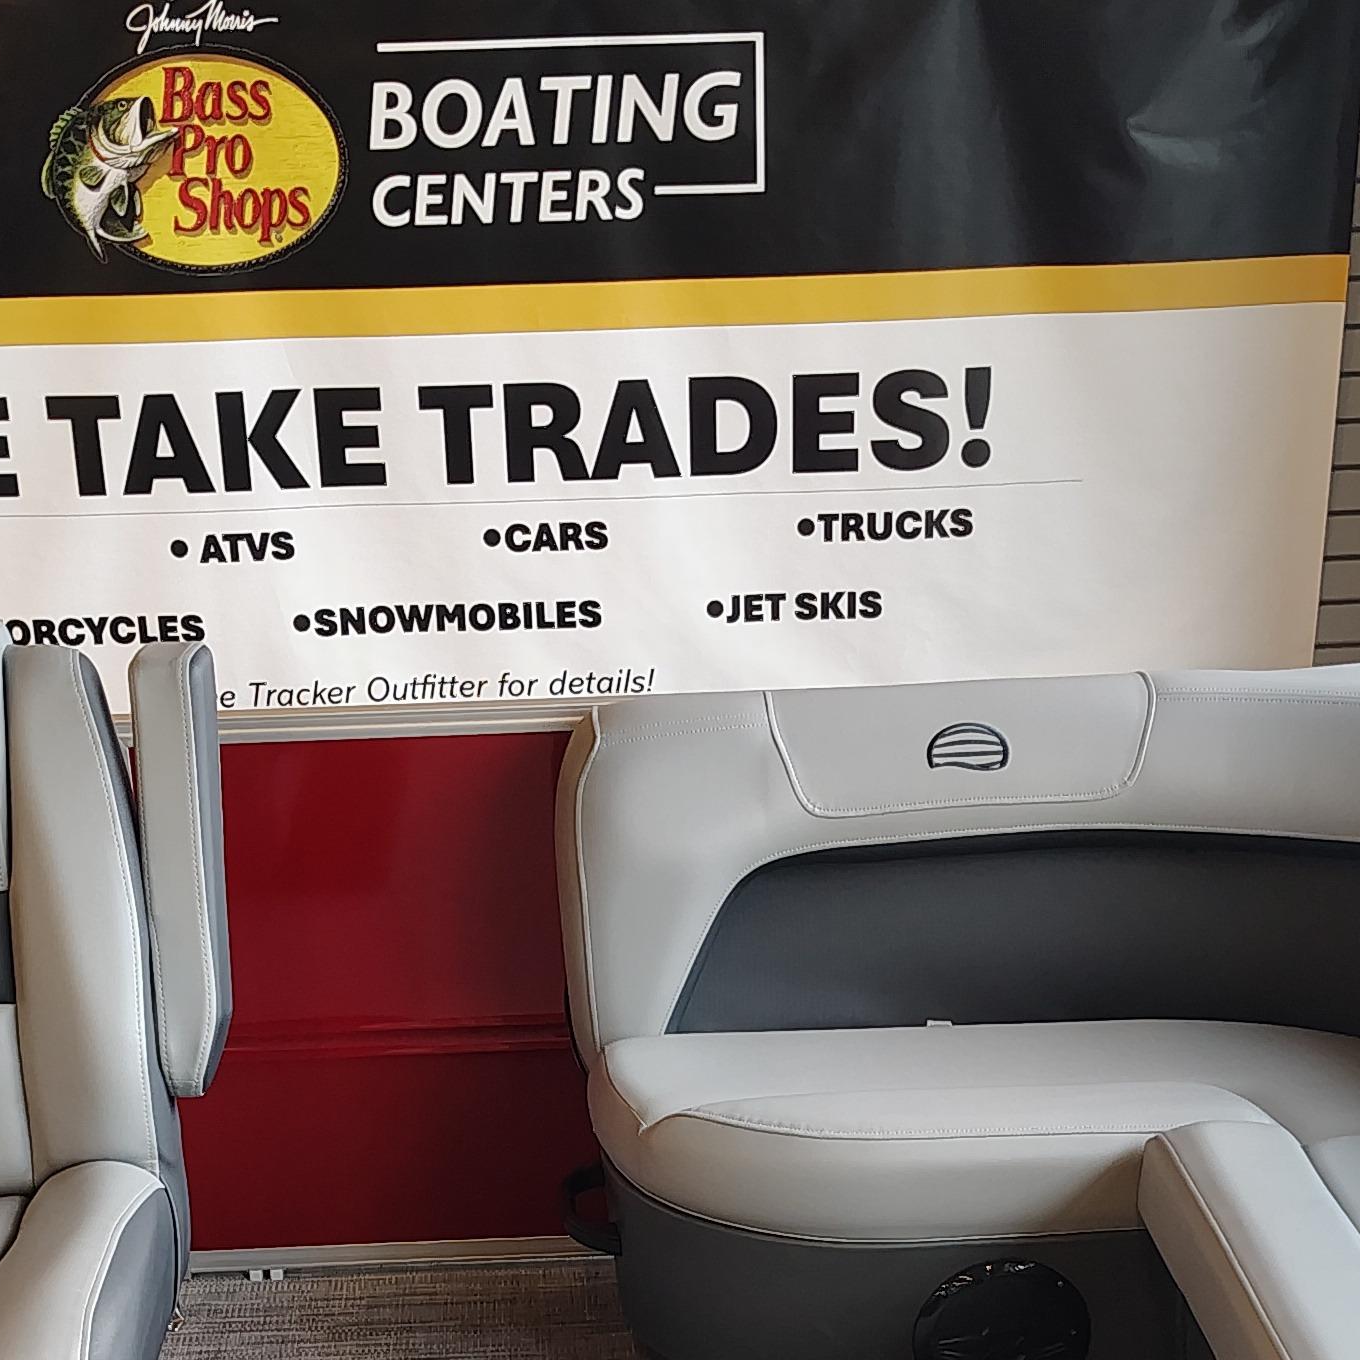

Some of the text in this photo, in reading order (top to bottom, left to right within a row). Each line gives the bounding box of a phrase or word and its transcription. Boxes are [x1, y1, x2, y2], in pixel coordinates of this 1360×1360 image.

[126, 0, 278, 54] Johnny Morris
[160, 66, 272, 123] Bass
[370, 71, 741, 151] BOATING
[168, 124, 253, 178] Pro
[174, 177, 311, 247] Shops
[372, 167, 645, 227] CENTERS
[44, 386, 388, 497] TAKE
[418, 366, 992, 485] TRADES!
[199, 531, 295, 564] ATVS
[504, 521, 609, 553] CARS
[817, 508, 974, 542] TRUCKS
[6, 614, 206, 647] ORCYCLES
[314, 599, 602, 637] SNOWMOBILES
[726, 590, 883, 624] JET SKIS
[248, 680, 356, 708] Tracker
[367, 673, 489, 702] Outfitter
[498, 672, 539, 697] for
[549, 668, 655, 696] details!
